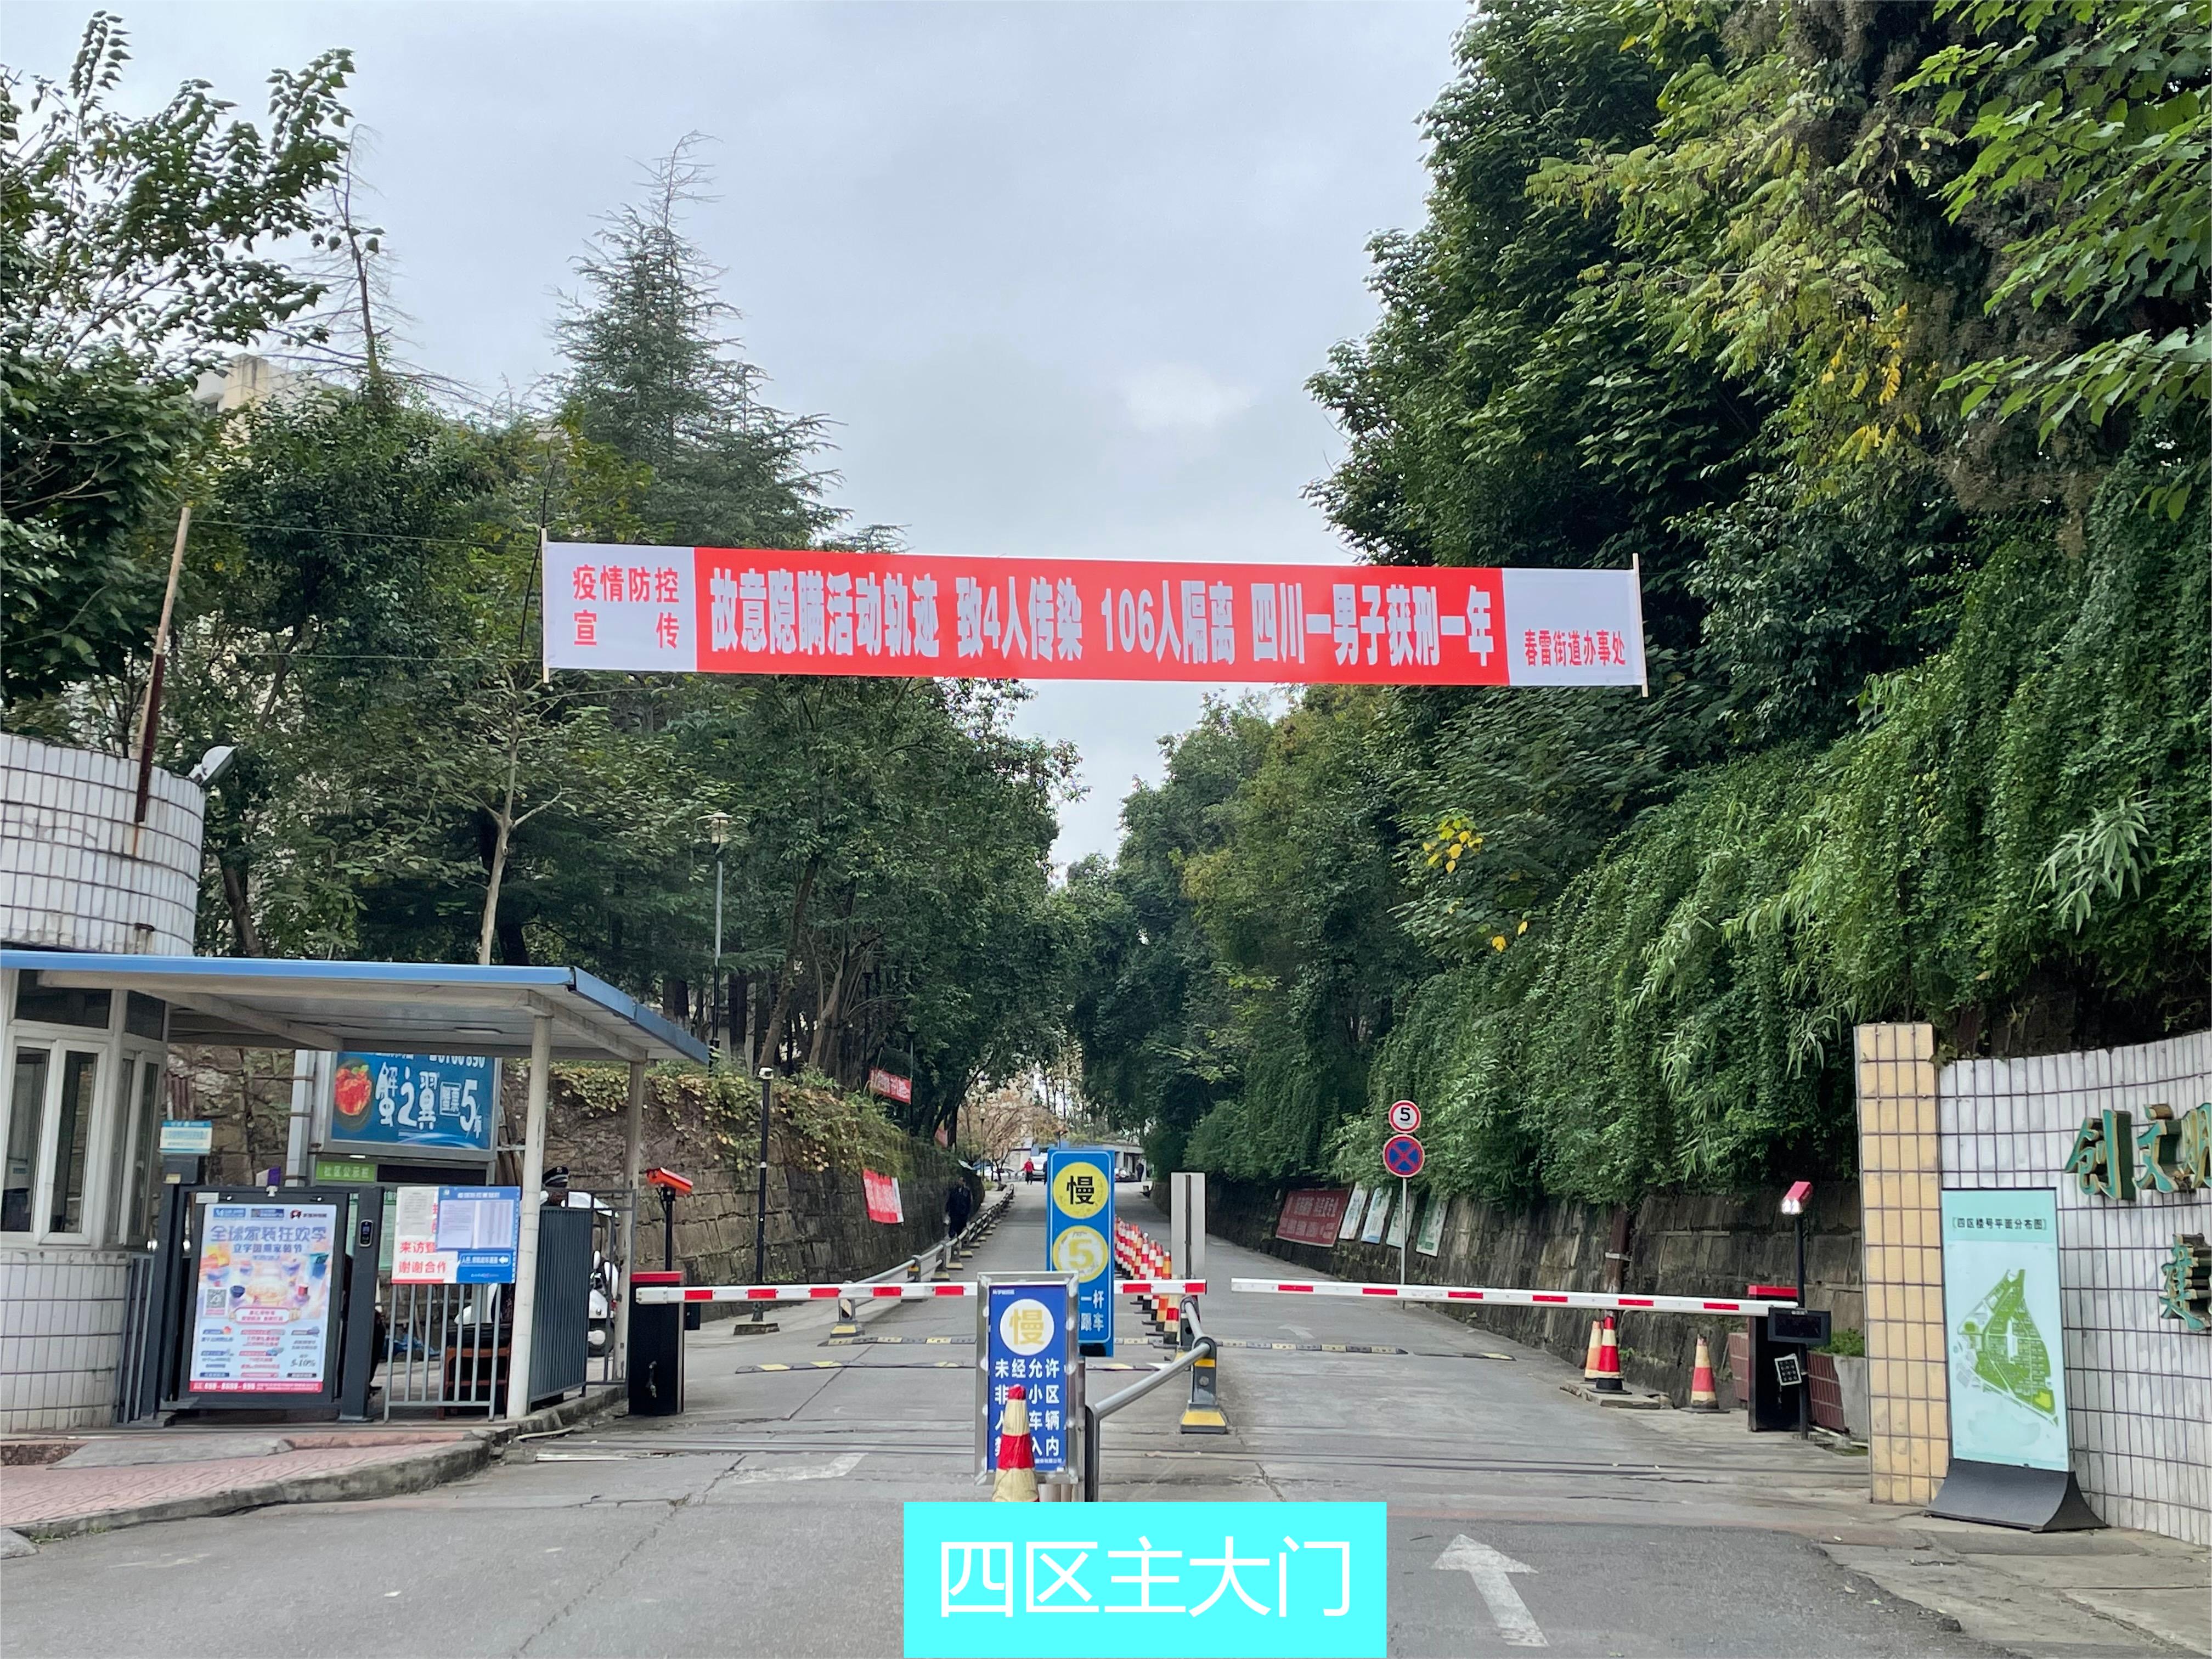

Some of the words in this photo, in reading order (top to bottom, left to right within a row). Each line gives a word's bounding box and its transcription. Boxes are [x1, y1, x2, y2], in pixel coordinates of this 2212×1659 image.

[573, 564, 680, 603] 疫情防控
[710, 567, 938, 657] 故意隐瞒活动轨迹
[956, 576, 1084, 662] 致4人传染
[1101, 580, 1235, 665] 106人隔离
[1251, 582, 1494, 668] 四川一男子获刑一年
[1524, 628, 1626, 668] 春雷街道办事处
[1400, 1107, 1411, 1121] 5
[1066, 1175, 1095, 1205] 慢
[398, 1260, 447, 1274] 谢谢合作
[1068, 1238, 1092, 1269] 5
[1009, 1308, 1045, 1346] 慢
[995, 1358, 1060, 1379] 未经允许
[995, 1384, 1060, 1405] 非小区
